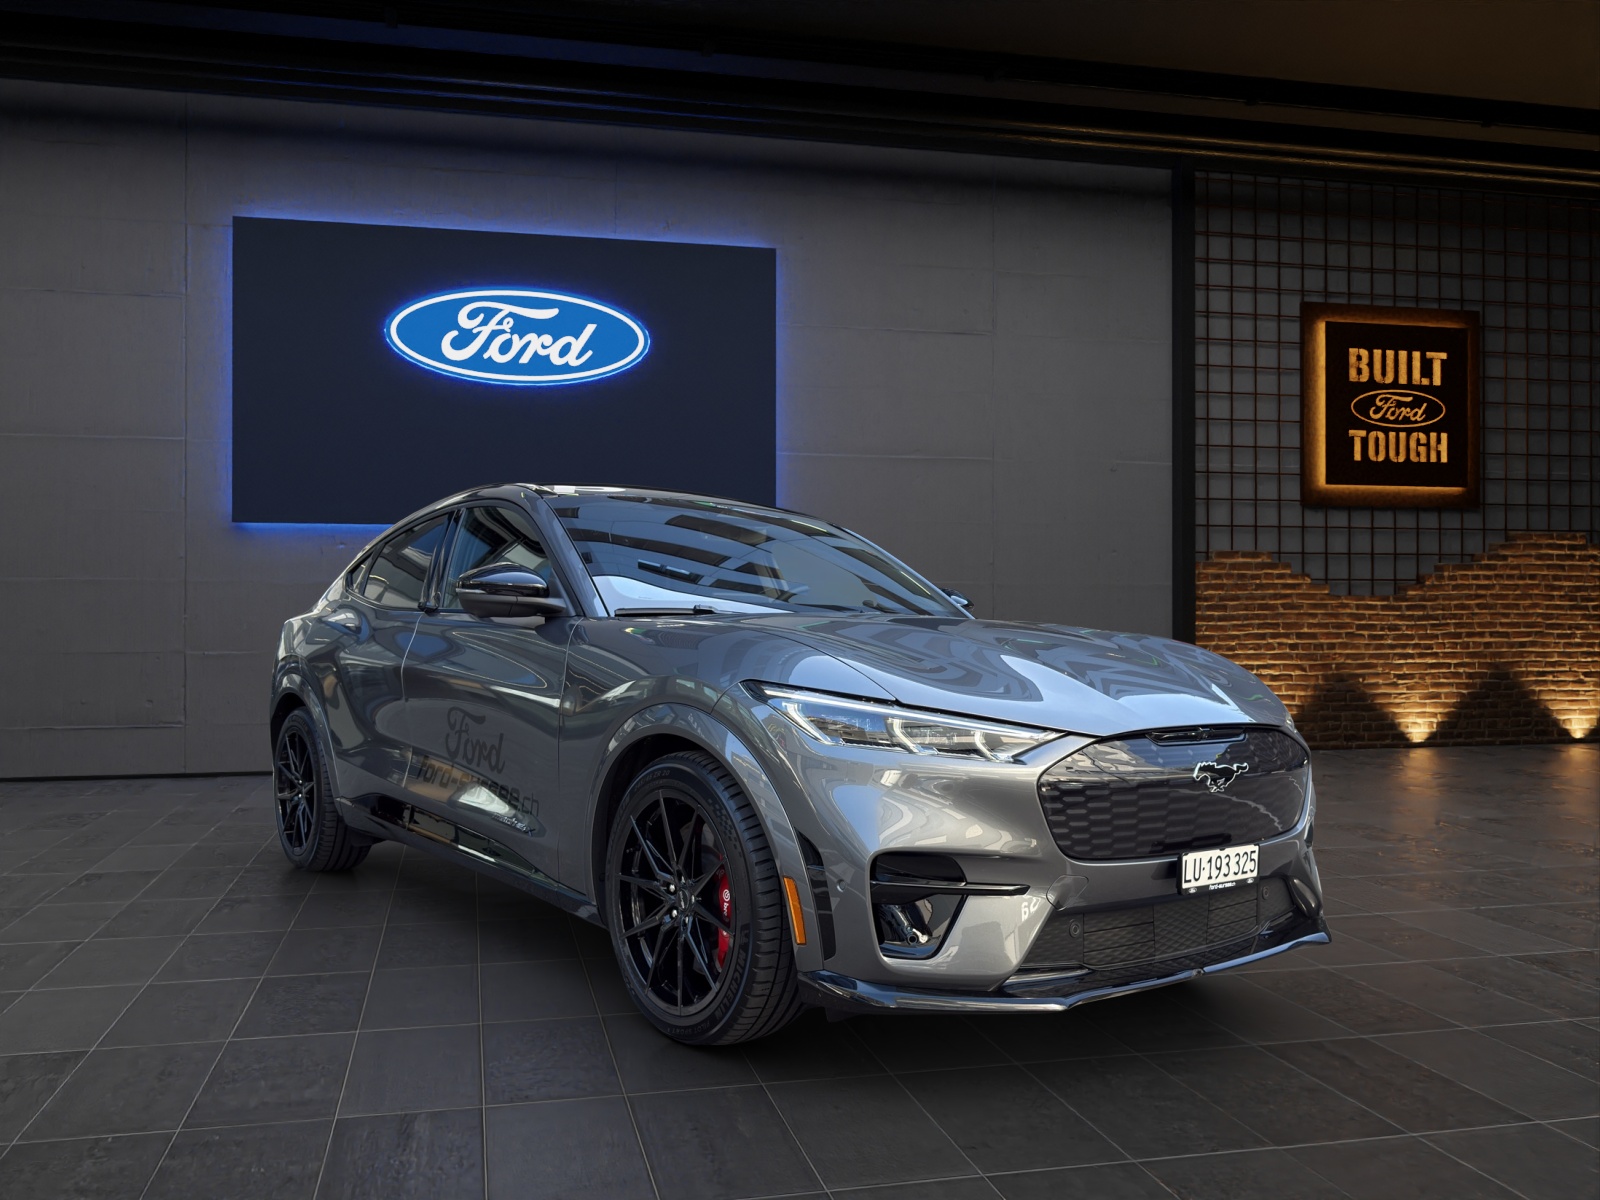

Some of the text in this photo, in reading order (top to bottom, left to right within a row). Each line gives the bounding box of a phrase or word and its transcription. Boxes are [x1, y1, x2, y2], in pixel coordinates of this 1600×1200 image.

[441, 301, 598, 367] Ford
[1348, 347, 1448, 386] BUILT
[1369, 394, 1428, 421] Ford
[1348, 429, 1448, 463] TOUGH
[446, 706, 505, 773] Ford
[714, 949, 746, 1019] MICHELIN
